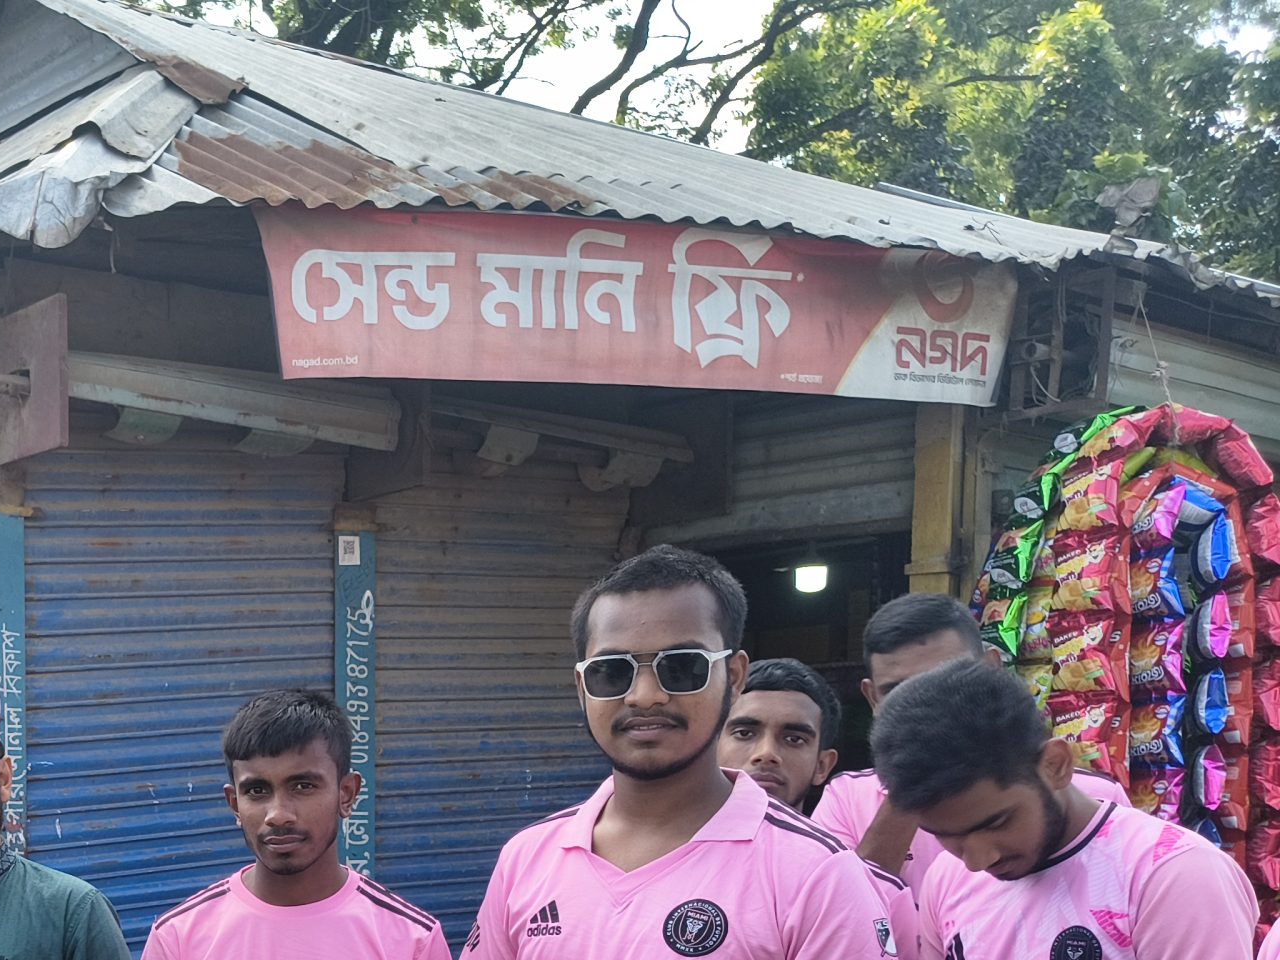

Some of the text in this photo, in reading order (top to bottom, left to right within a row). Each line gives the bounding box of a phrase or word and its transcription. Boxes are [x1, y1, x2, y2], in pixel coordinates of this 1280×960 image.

[291, 249, 456, 330] সেন্ড
[476, 228, 644, 333] মানি
[895, 326, 991, 376] নগদ
[291, 355, 359, 368] nagad.com.bd
[1056, 712, 1081, 722] BAKED
[687, 911, 709, 921] MIAMI
[526, 921, 562, 938] adidas
